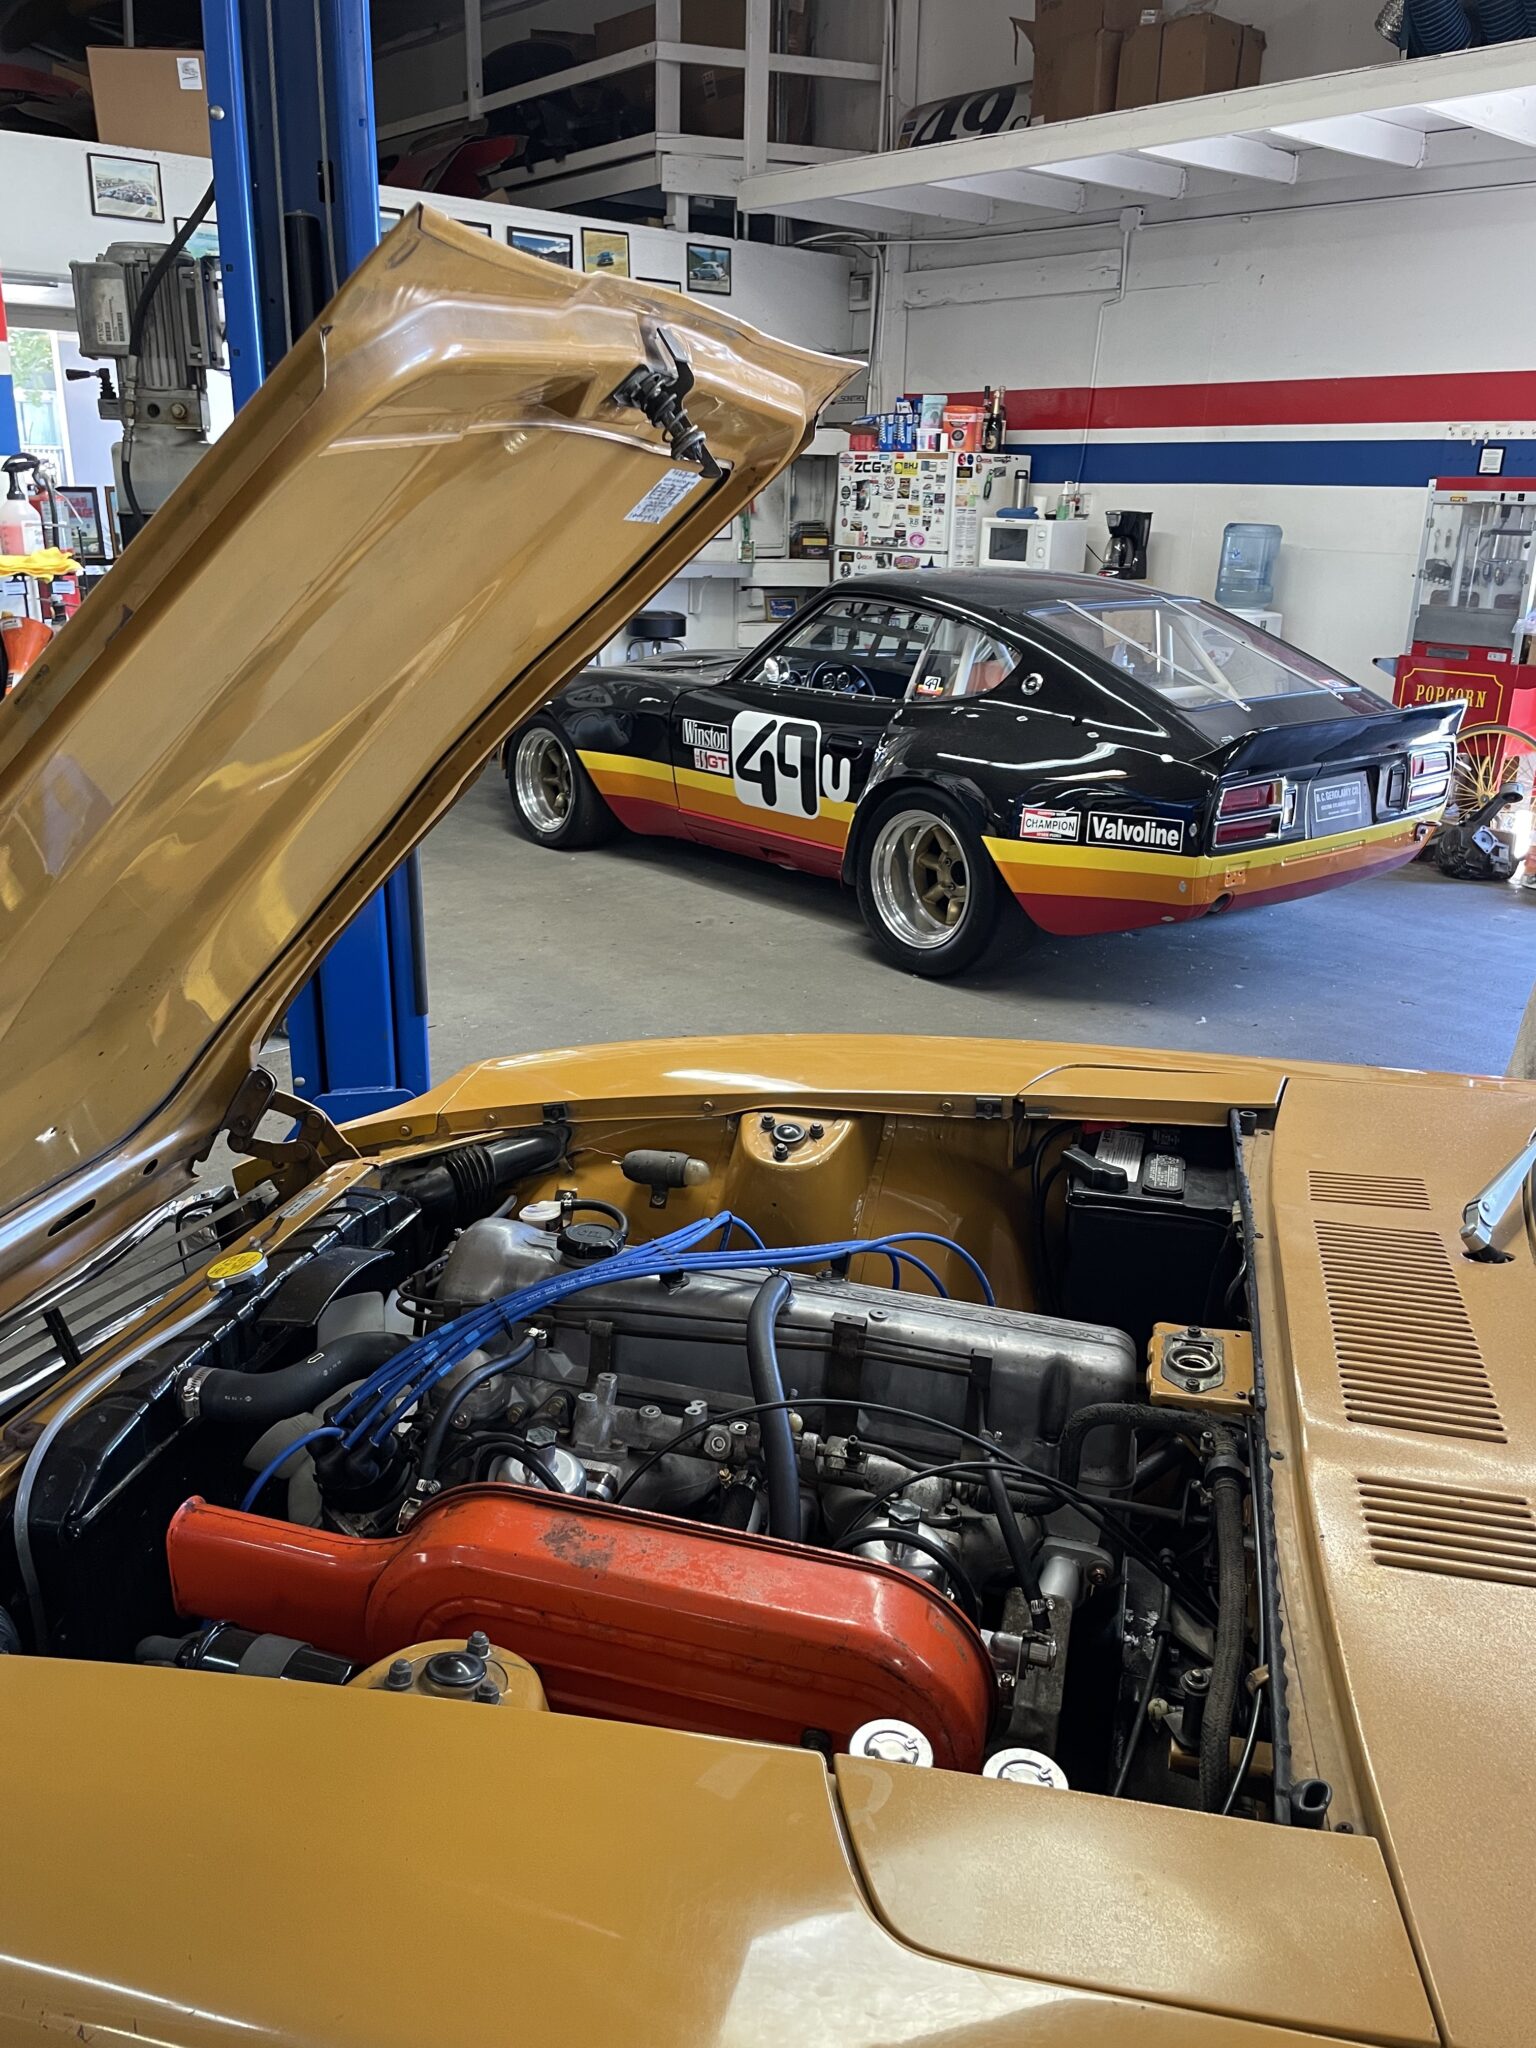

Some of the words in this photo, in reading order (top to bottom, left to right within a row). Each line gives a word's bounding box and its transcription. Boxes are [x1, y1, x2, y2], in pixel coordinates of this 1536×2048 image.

[854, 461, 882, 473] ZCG
[1415, 684, 1487, 708] POPCORN
[684, 720, 727, 749] Winston
[707, 754, 728, 770] GT
[735, 719, 818, 816] 49
[1026, 818, 1075, 831] CHAMPION
[1092, 816, 1179, 847] Valvoline
[984, 1313, 1105, 1341] NISSAN
